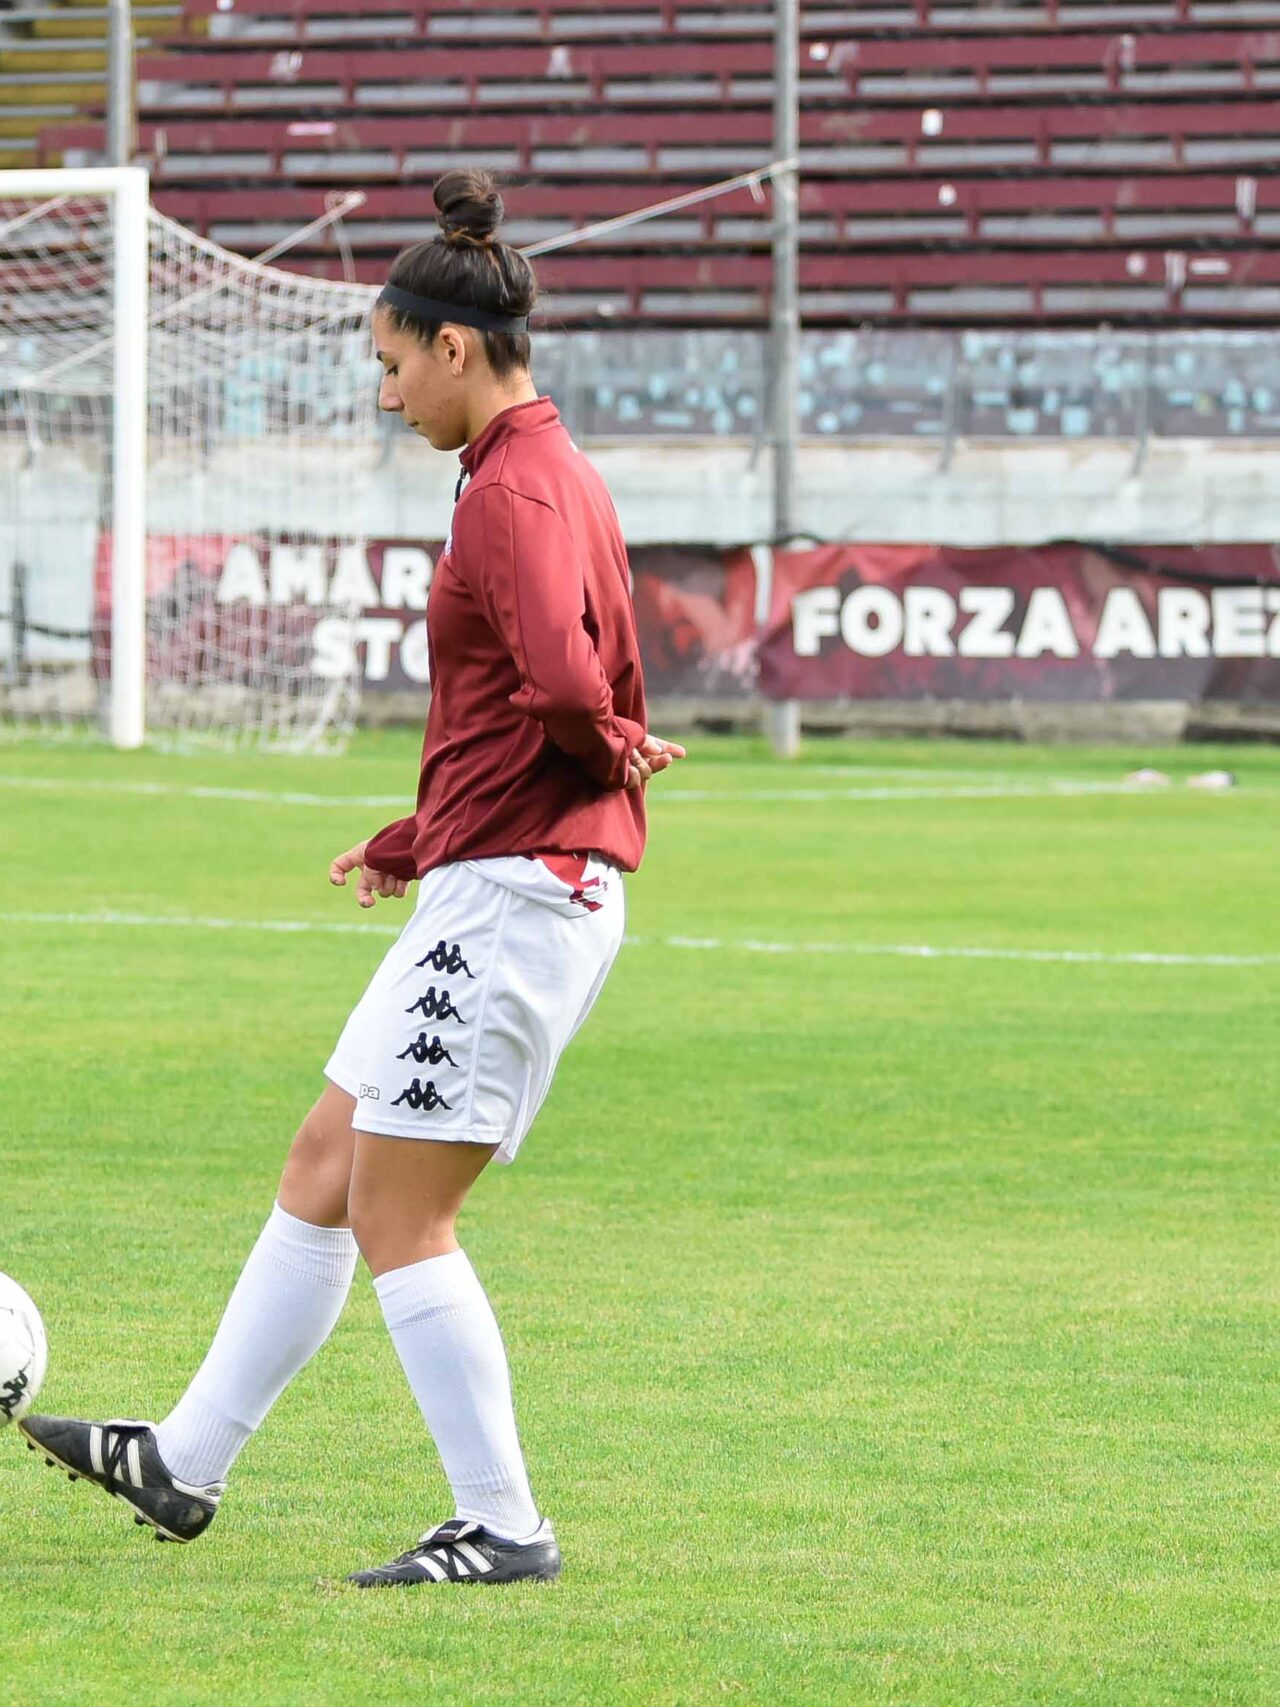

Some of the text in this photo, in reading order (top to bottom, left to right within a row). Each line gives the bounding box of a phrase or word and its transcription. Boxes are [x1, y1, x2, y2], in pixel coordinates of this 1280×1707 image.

[216, 543, 435, 610] AMAR
[791, 585, 1280, 659] FORZA ARE
